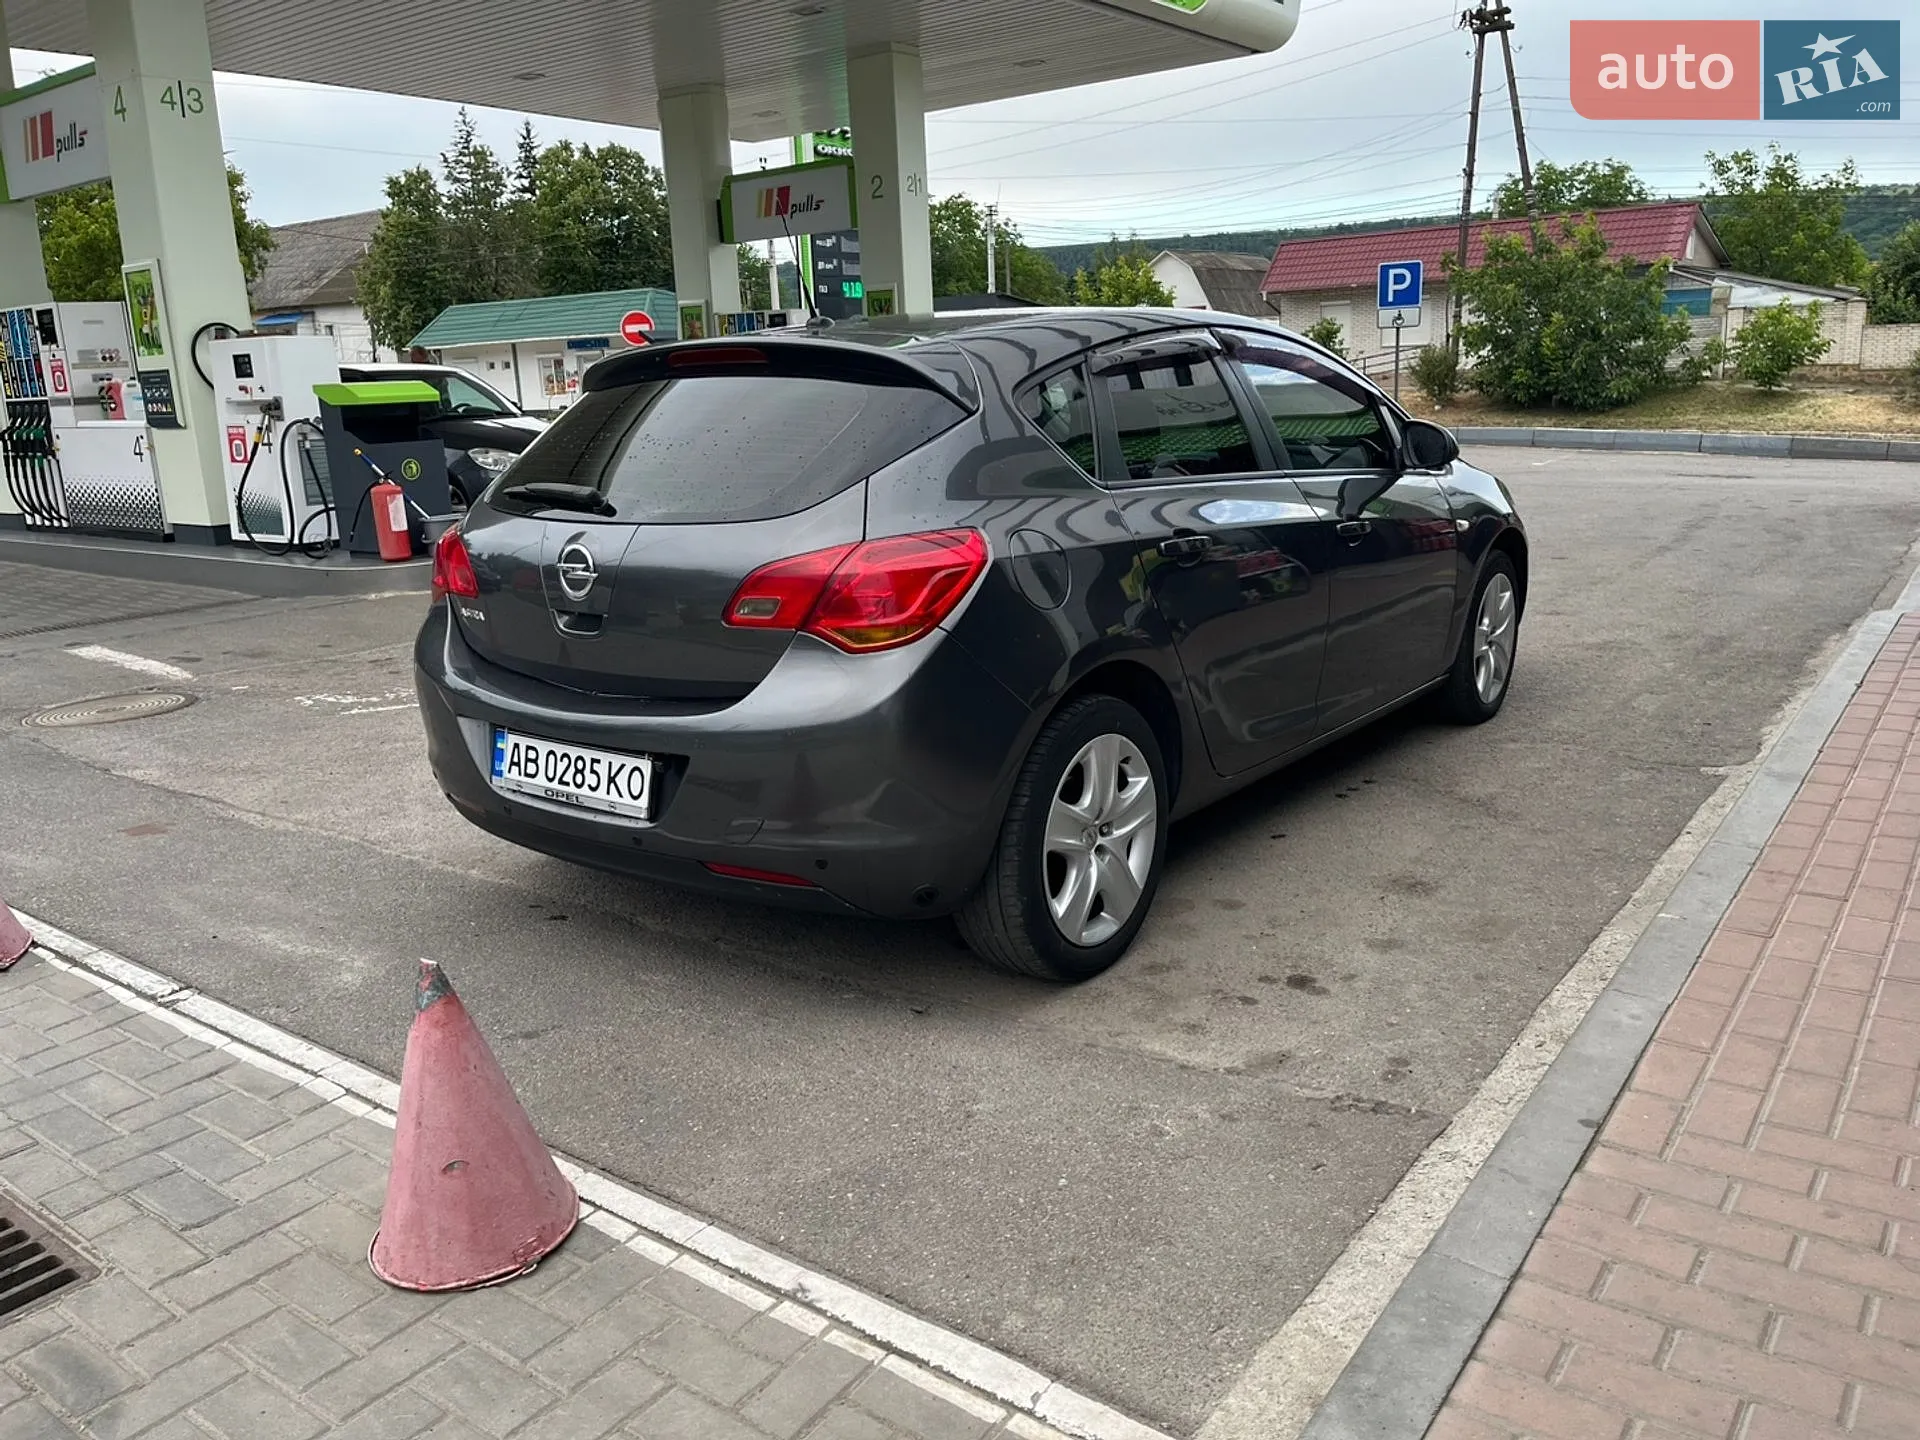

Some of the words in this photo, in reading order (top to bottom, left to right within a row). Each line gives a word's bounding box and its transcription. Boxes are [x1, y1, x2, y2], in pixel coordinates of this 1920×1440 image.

[113, 85, 127, 122] 4
[56, 121, 88, 162] pulls
[871, 175, 884, 199] 2
[790, 194, 824, 219] pulls
[1388, 268, 1412, 303] P
[133, 435, 144, 462] 4
[508, 743, 539, 780] AB
[545, 750, 601, 792] 0285
[606, 761, 645, 800] KO
[543, 789, 585, 806] OPEL
